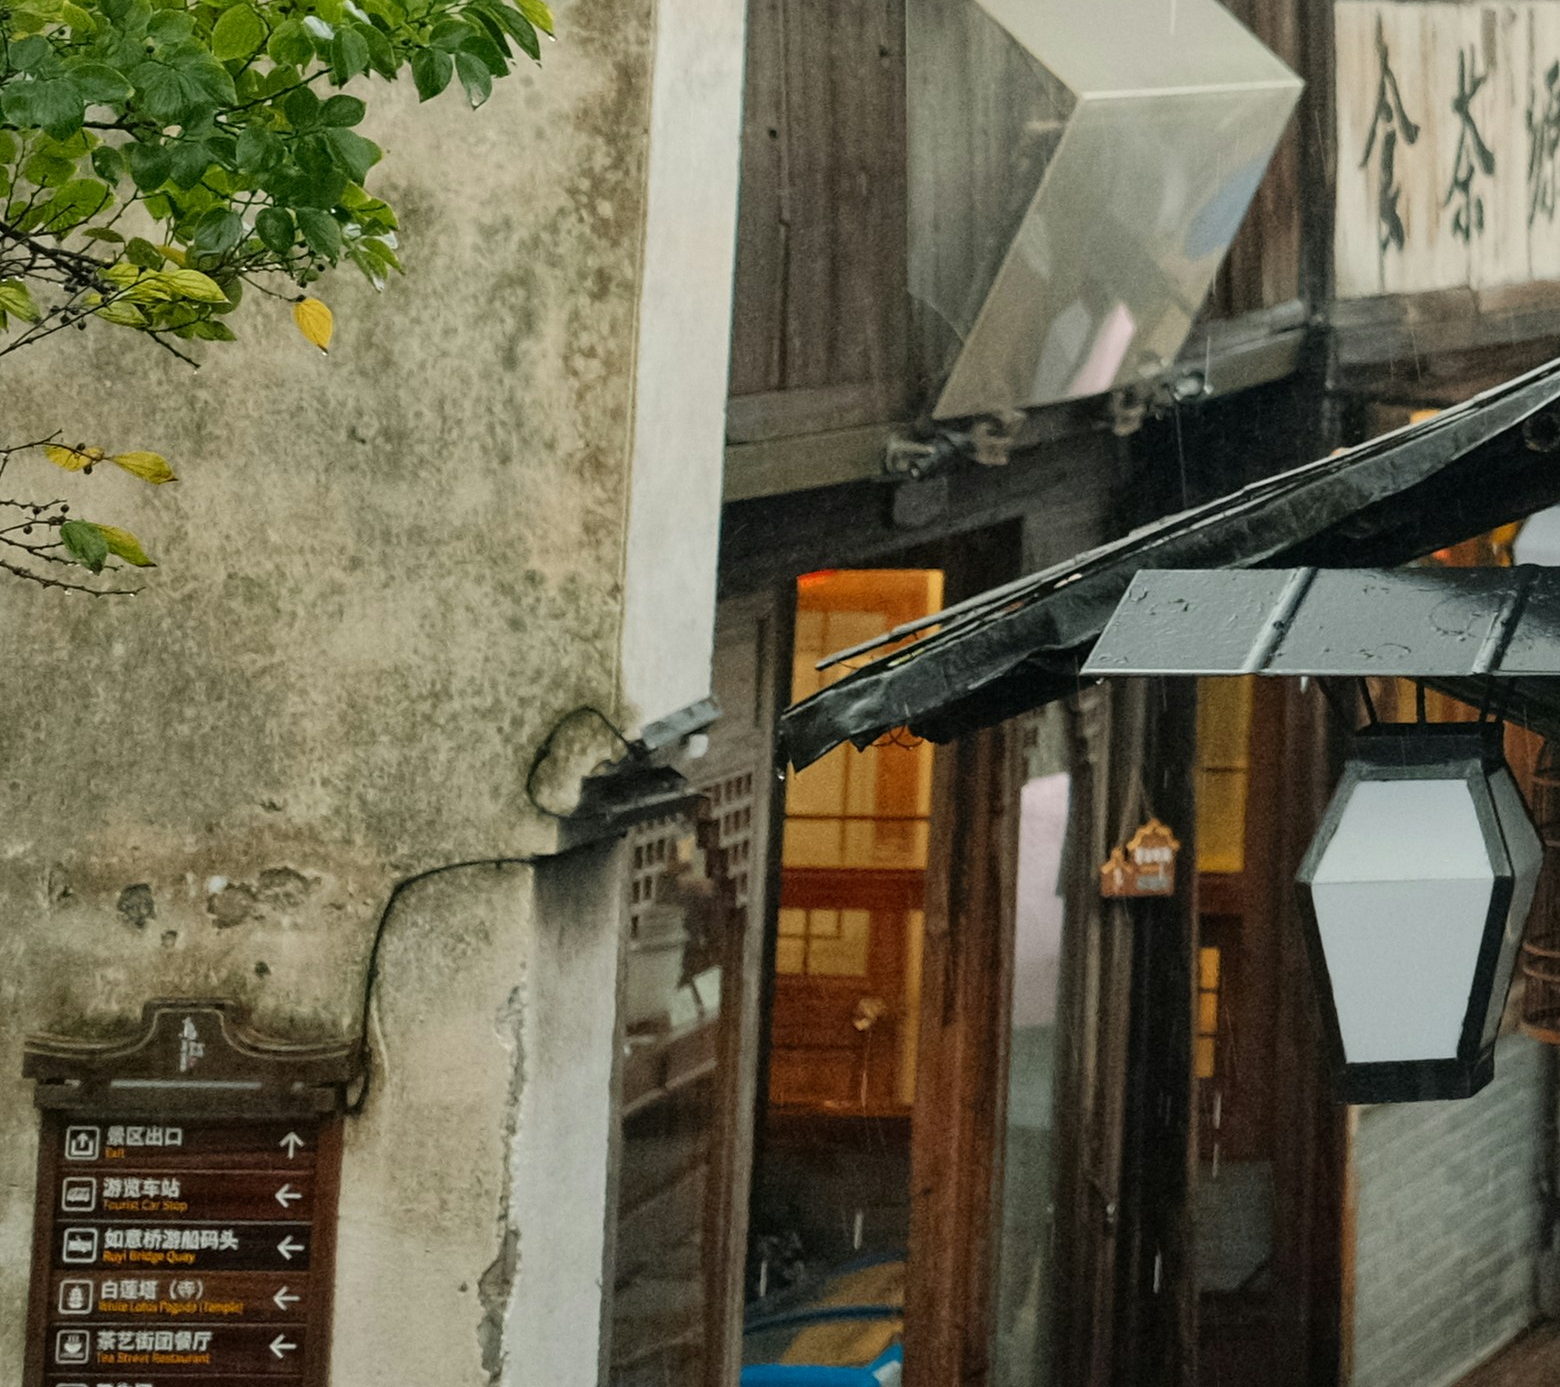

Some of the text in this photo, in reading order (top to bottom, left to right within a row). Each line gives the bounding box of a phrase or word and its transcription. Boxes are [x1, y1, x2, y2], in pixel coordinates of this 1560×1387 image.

[106, 1126, 183, 1146] 景区出口
[103, 1178, 180, 1198] 游览车站
[104, 1229, 239, 1250] 如意桥游船码头
[103, 1251, 196, 1264] Ruyi Bridge Quay
